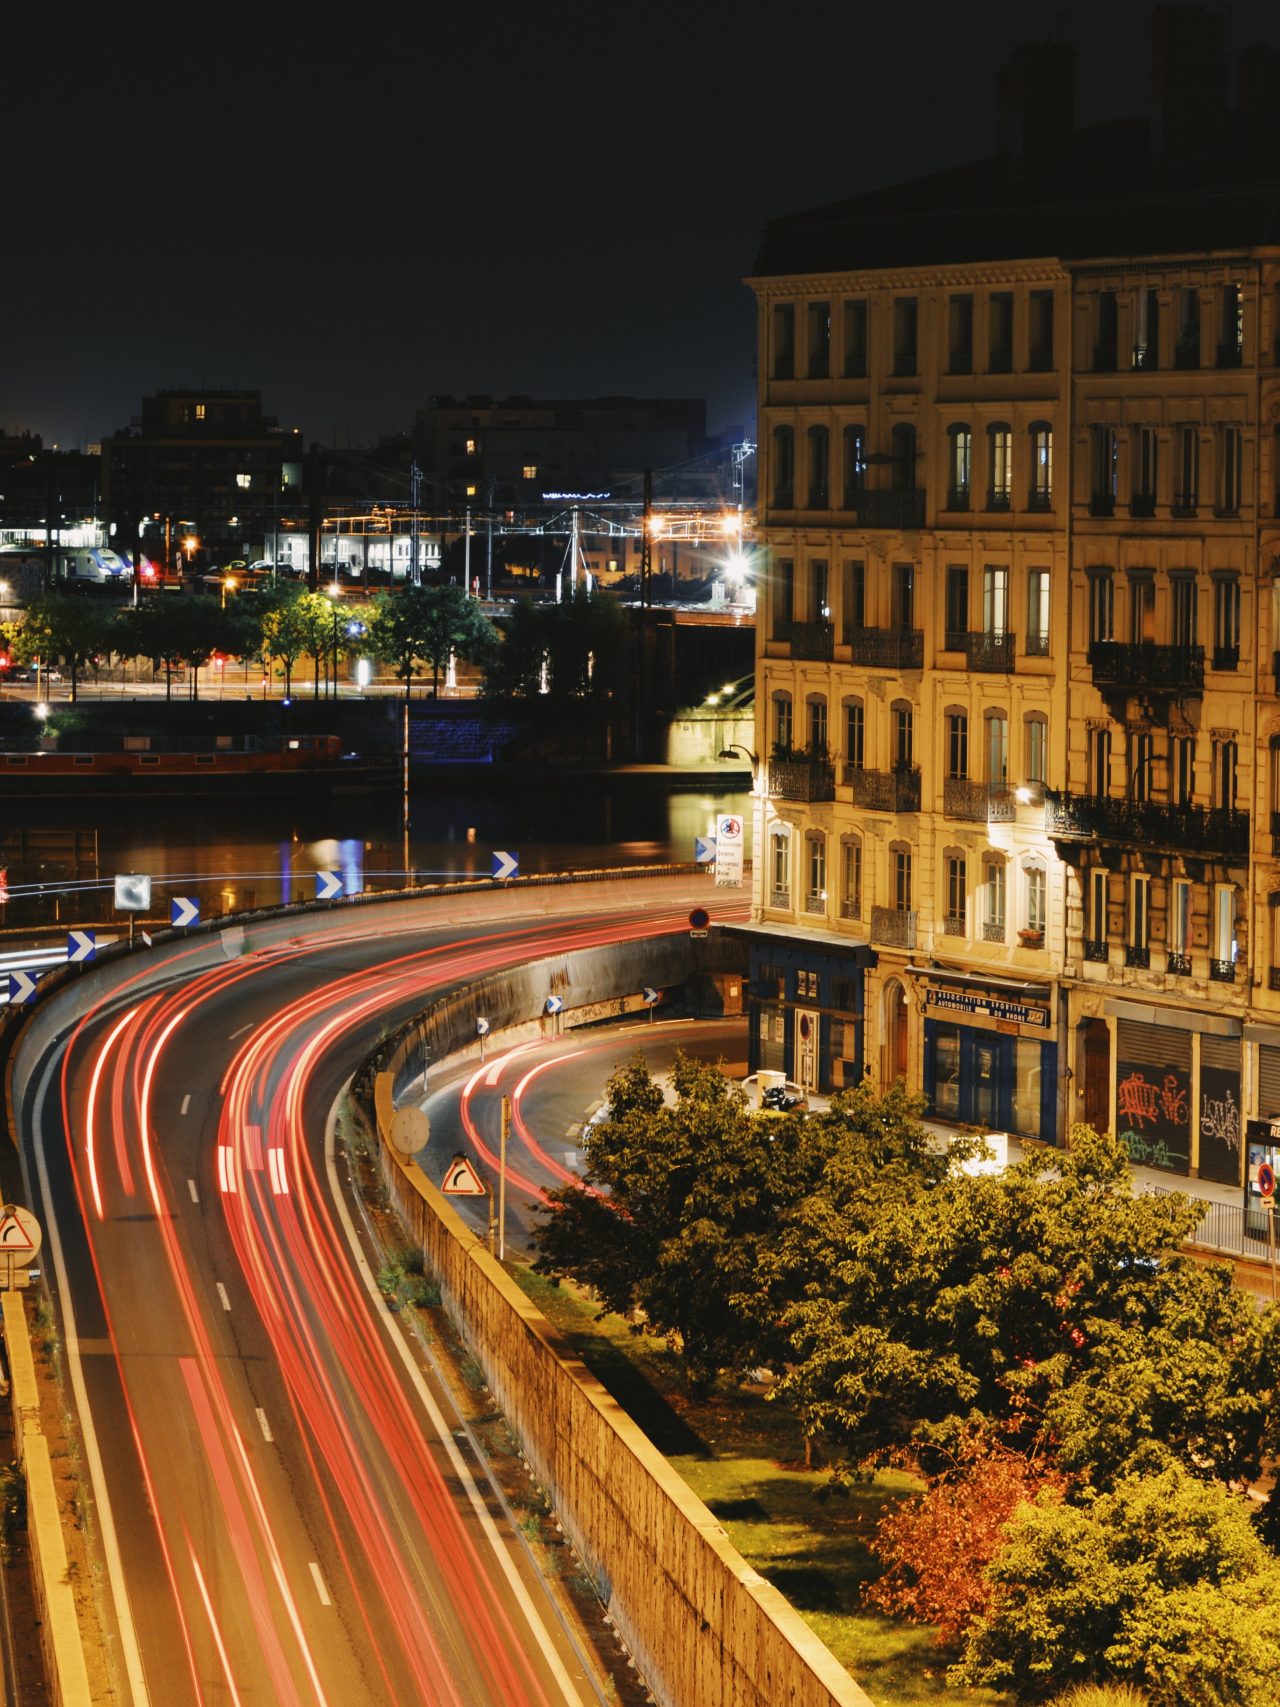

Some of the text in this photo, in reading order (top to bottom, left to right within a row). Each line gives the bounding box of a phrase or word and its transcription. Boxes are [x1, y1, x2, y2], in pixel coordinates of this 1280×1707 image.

[937, 1000, 972, 1012] AUTOMOBILE
[994, 1010, 1002, 1018] DU
[1006, 1012, 1025, 1022] RHONE
[938, 992, 1026, 1014] ASSOCIATION SPORTIVE
